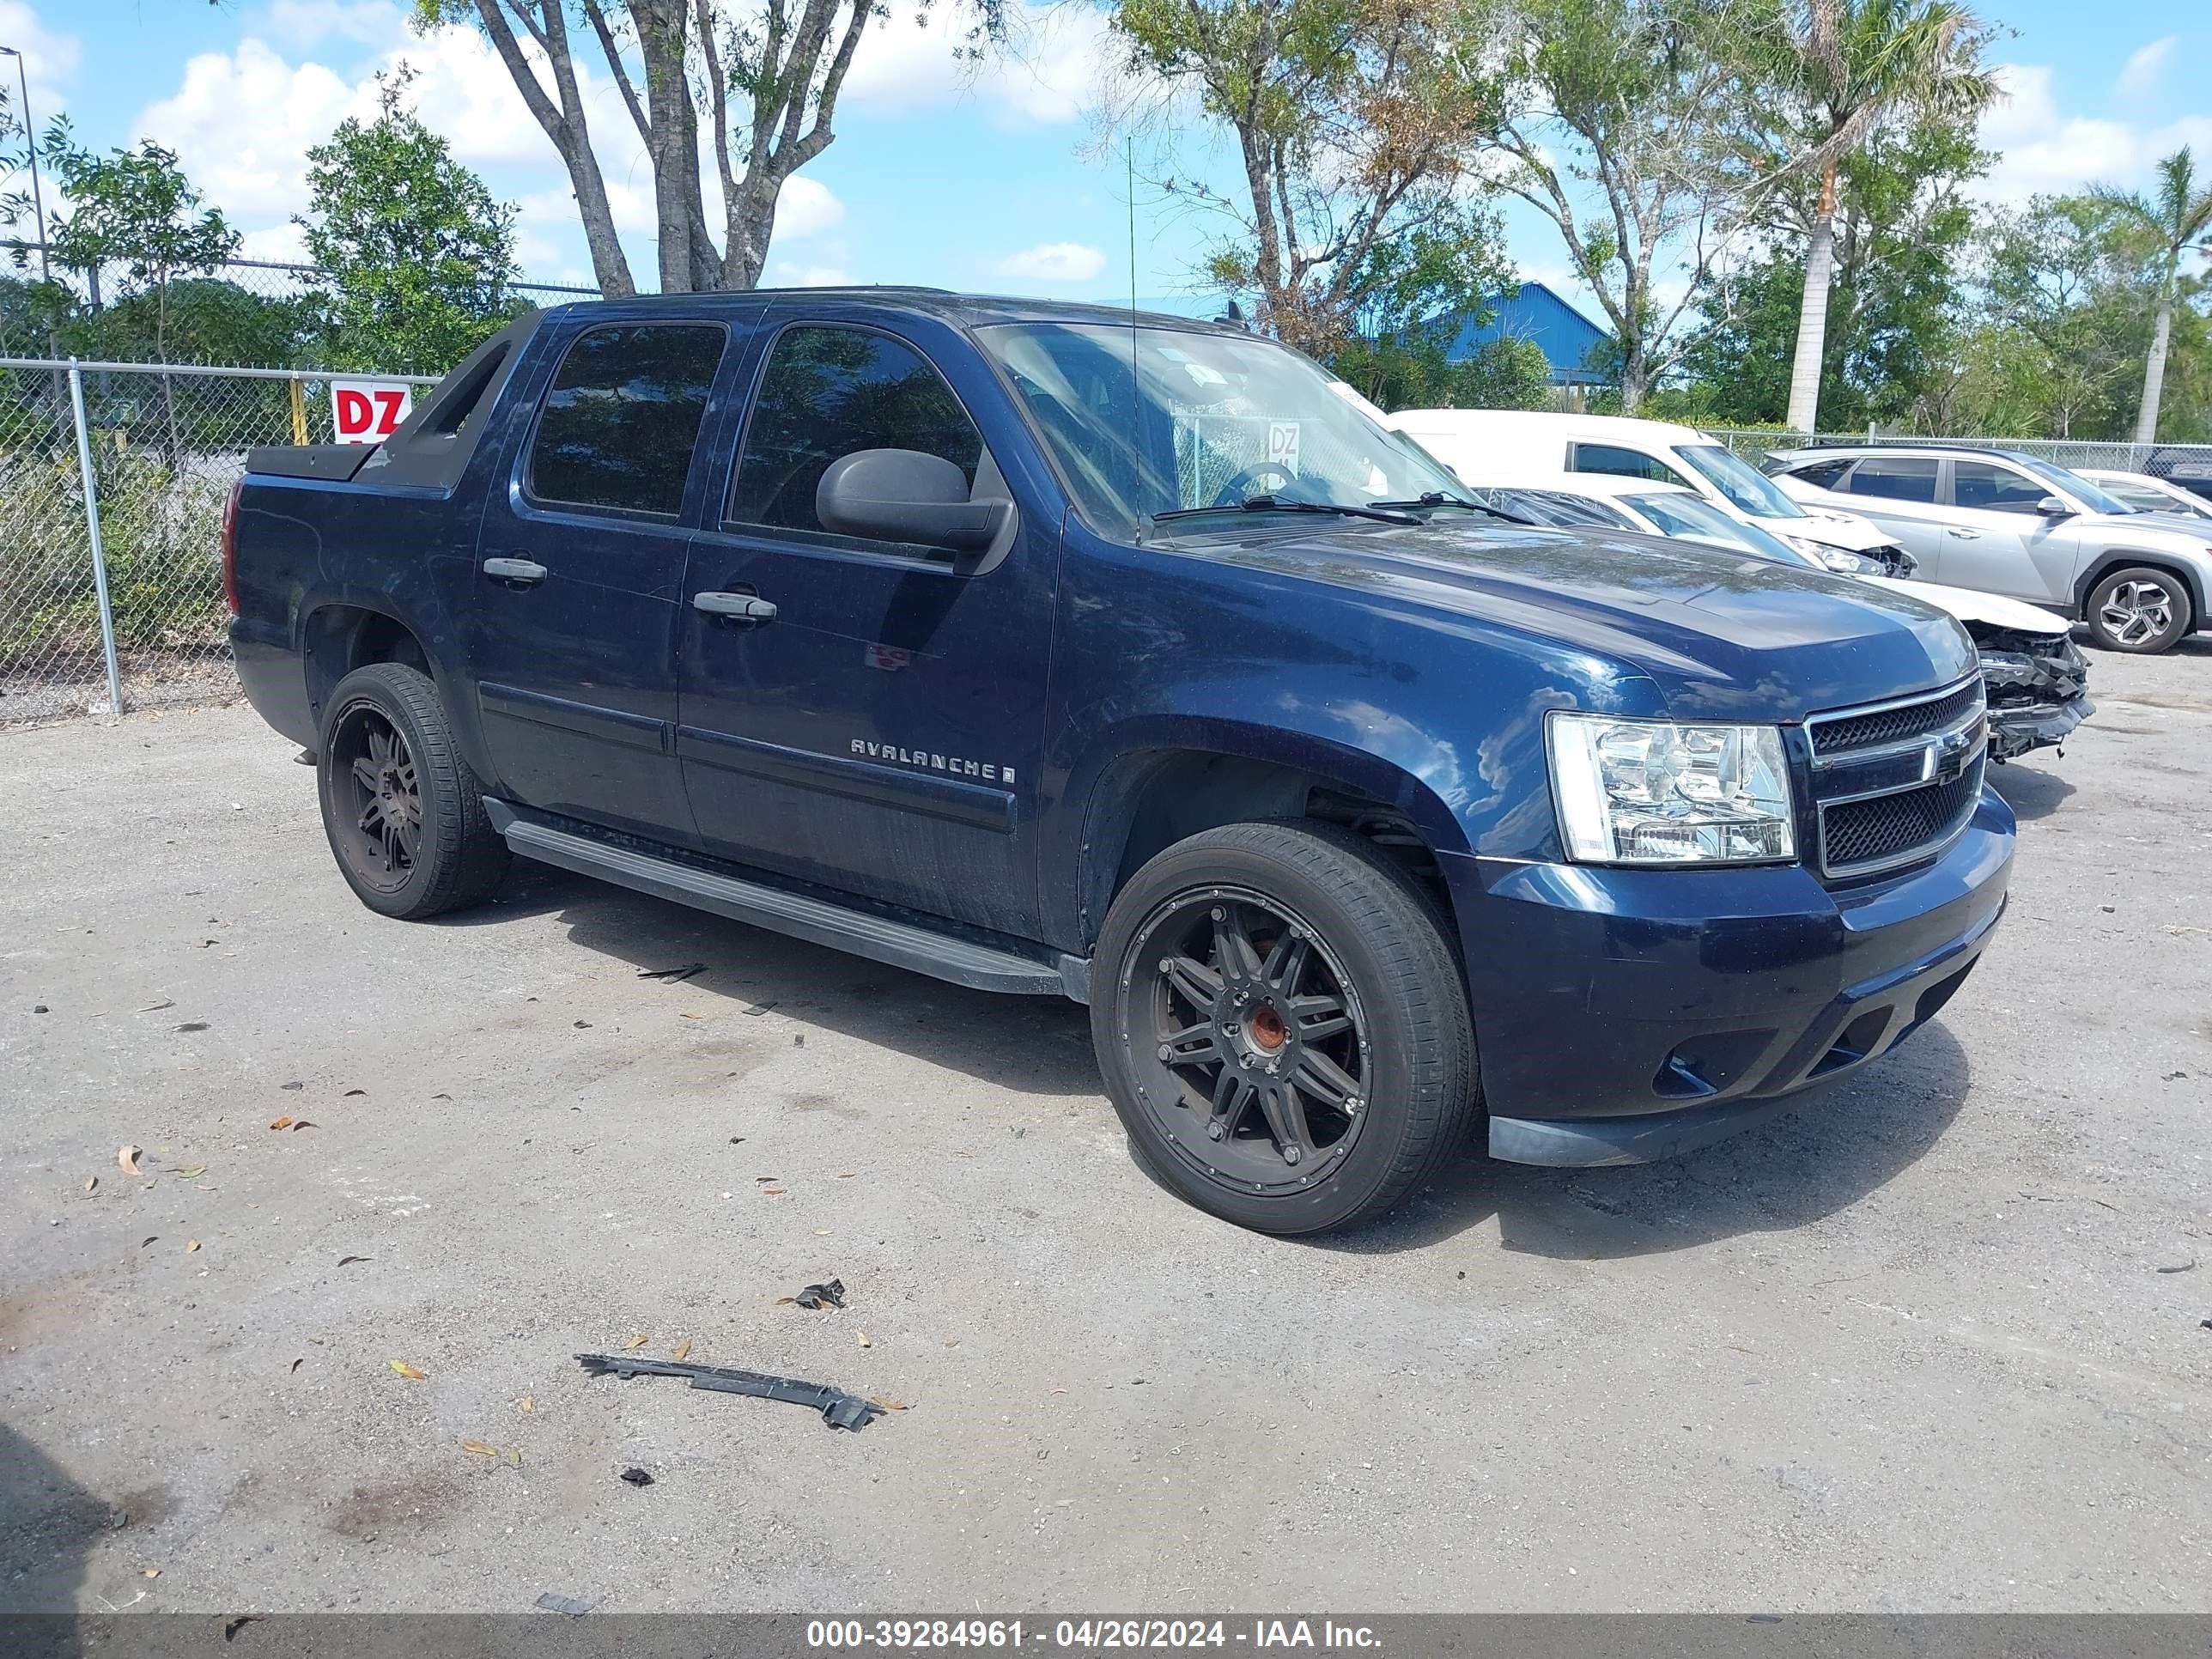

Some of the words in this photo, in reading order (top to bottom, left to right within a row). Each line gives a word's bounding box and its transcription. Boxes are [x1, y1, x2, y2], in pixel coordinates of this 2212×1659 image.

[337, 390, 405, 434] DZ
[1272, 427, 1297, 454] DZ
[851, 738, 995, 780] AVALANCHE
